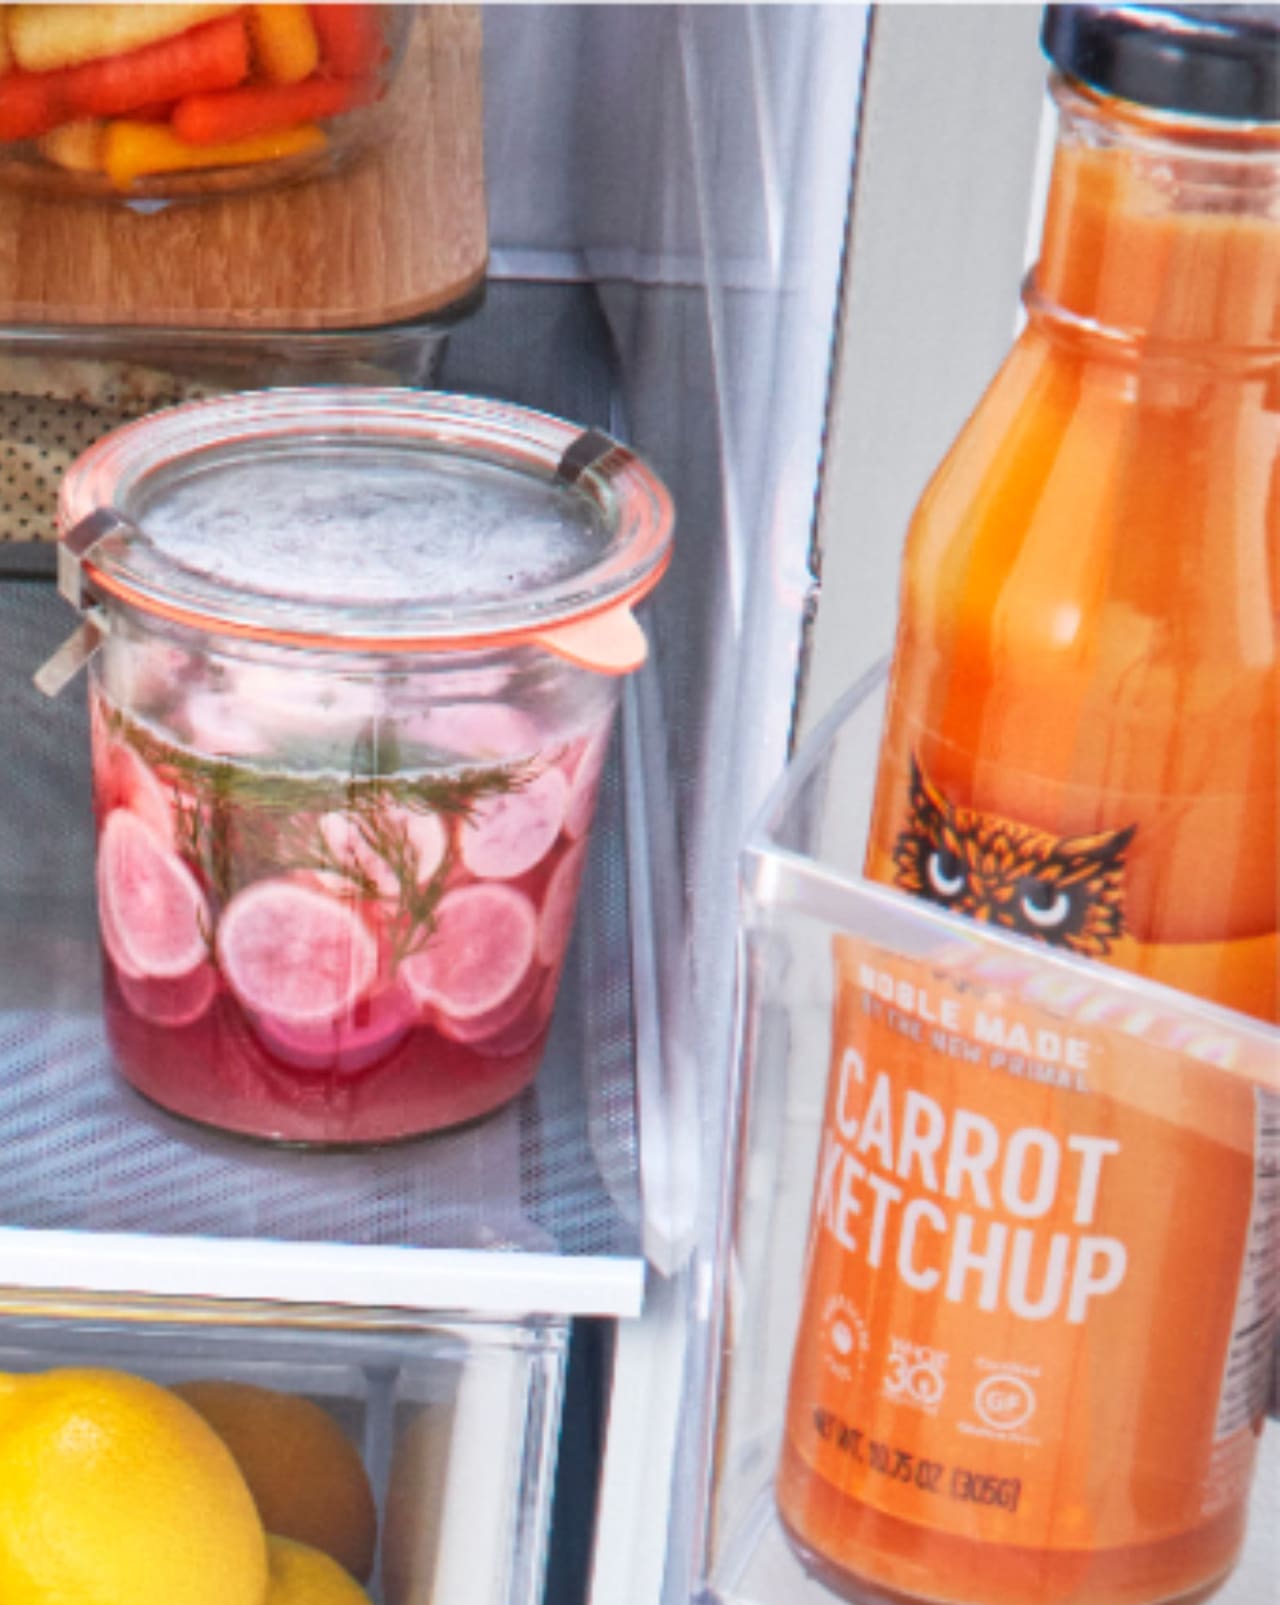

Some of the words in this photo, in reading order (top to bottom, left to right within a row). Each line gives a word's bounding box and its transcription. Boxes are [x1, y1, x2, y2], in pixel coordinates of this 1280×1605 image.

[859, 963, 961, 1030] NOBLE
[974, 1010, 1090, 1069] MADE
[887, 1007, 924, 1042] THE
[930, 1028, 982, 1064] NEW
[990, 1050, 1091, 1093] PRIMAL
[834, 1046, 1119, 1225] CARROT
[816, 1128, 1128, 1325] KETCHUP
[869, 1440, 913, 1483] 10.75
[914, 1458, 945, 1493] OZ
